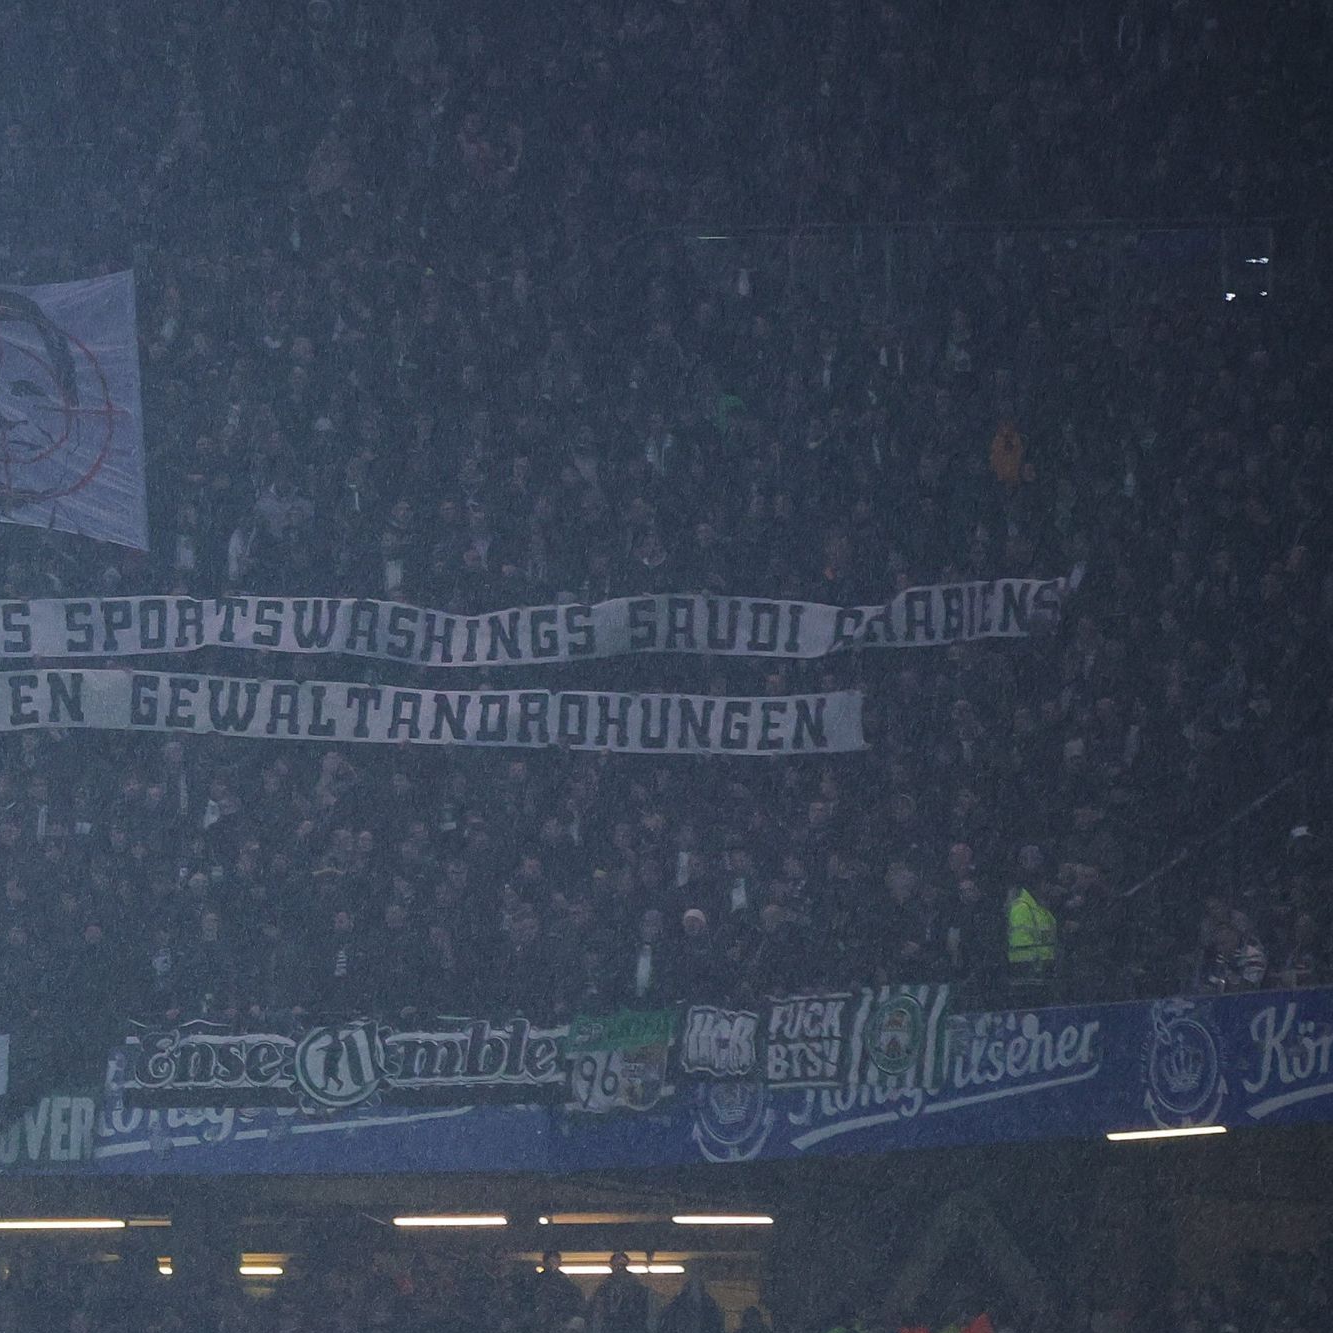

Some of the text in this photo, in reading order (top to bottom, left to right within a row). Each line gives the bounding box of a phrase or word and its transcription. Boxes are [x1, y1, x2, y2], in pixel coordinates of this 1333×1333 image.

[66, 597, 595, 664] SPORTSWASHINGS
[635, 600, 803, 654] SAUDI
[133, 674, 827, 750] GEWALTANDROHUNGEN
[768, 1001, 845, 1039] FUCK
[767, 1040, 841, 1081] BTSV
